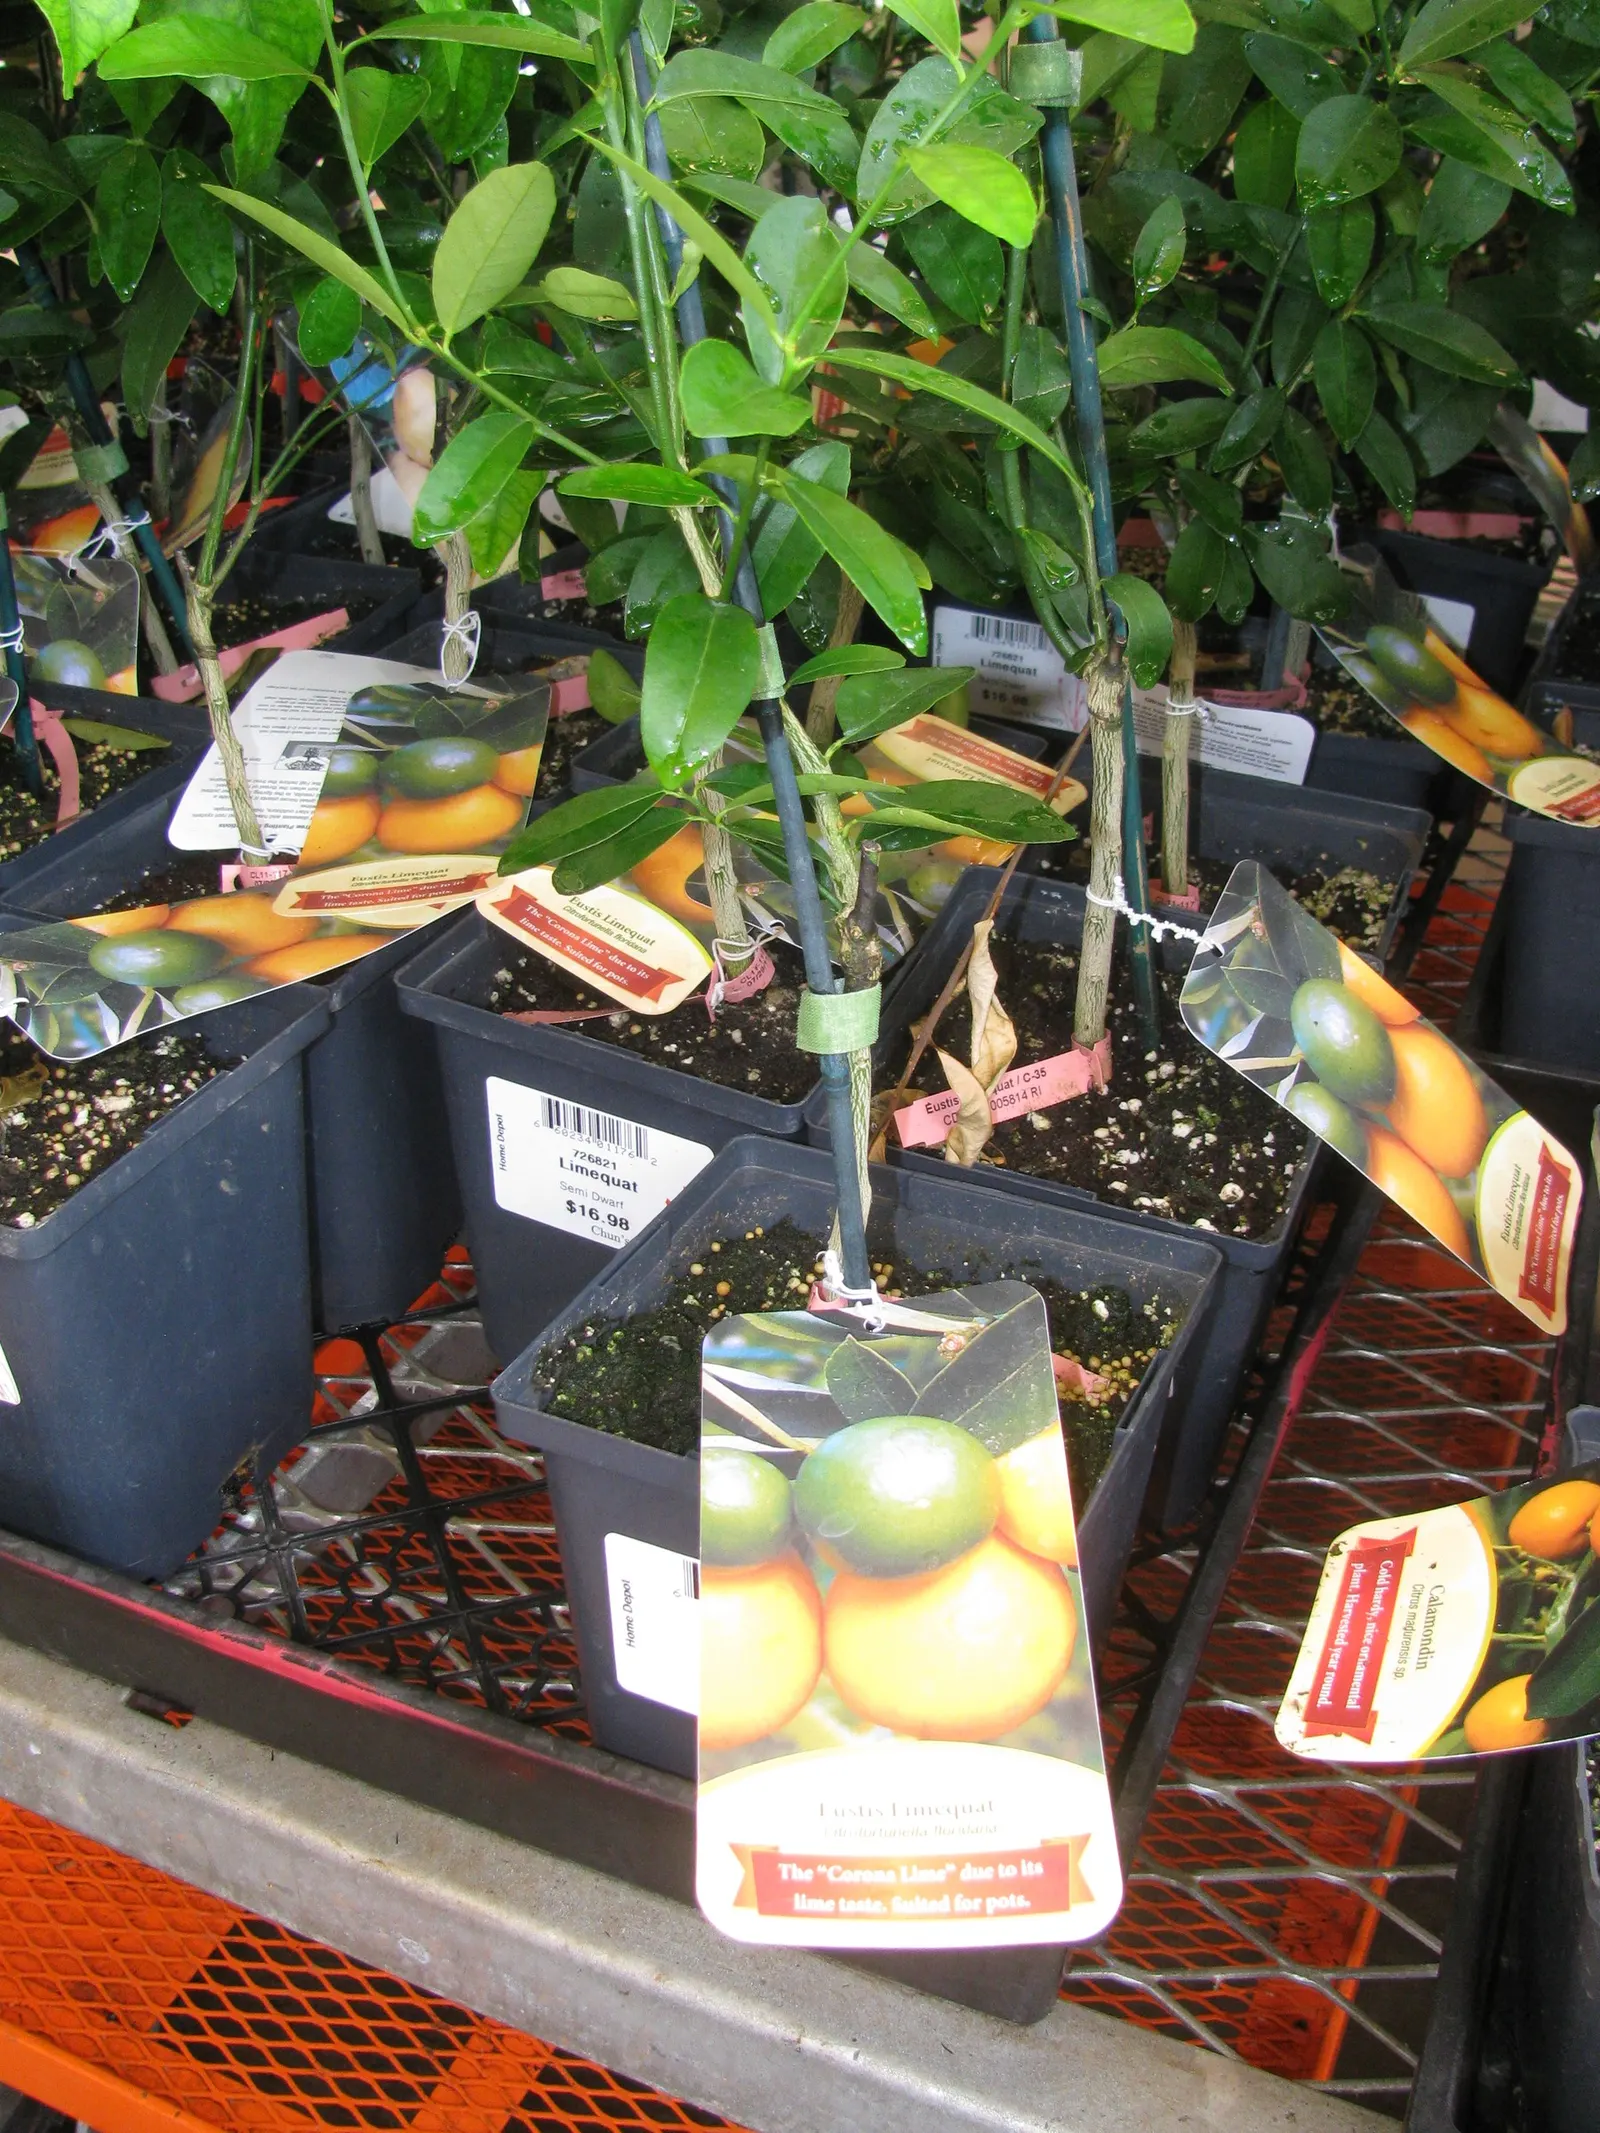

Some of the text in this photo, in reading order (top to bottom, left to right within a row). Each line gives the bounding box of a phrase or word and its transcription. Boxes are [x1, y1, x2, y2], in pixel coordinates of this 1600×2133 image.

[980, 658, 1038, 677] Limequat
[351, 868, 450, 882] Eustis Limequat
[387, 886, 418, 895] Lime”
[419, 883, 438, 891] due
[349, 898, 375, 906] taste.
[378, 894, 409, 903] Suited
[427, 889, 453, 898] pots.
[562, 905, 648, 954] Citrofortunella floridana
[569, 896, 656, 946] Eustis Limequat
[519, 917, 629, 986] lime taste. Suited for pots.
[525, 904, 649, 980] The “Corona Lime” due to its
[925, 1097, 960, 1114] Eustis
[1022, 1067, 1047, 1083] C-35
[1031, 1086, 1042, 1098] RI
[495, 1113, 507, 1171] Home Depot
[533, 1119, 541, 1128] 6
[651, 1157, 658, 1166] 2
[572, 1149, 617, 1171] 726821
[559, 1157, 639, 1193] Limequat
[560, 1181, 624, 1210] Semi Dwarf
[1544, 1173, 1553, 1184] its
[566, 1199, 630, 1231] $16.98
[1501, 1163, 1522, 1244] Eustis Limequat
[1540, 1194, 1549, 1211] due
[1543, 1273, 1551, 1294] lime
[1548, 1226, 1558, 1250] Suited
[1556, 1194, 1565, 1215] pots.
[1529, 1270, 1538, 1286] The
[621, 1579, 636, 1648] Home Depot
[1394, 1583, 1425, 1681] Citrus madurensis sp.
[1416, 1584, 1446, 1671] Calamondin
[1316, 1562, 1366, 1708] plant. Harvested year round.
[1346, 1560, 1394, 1709] Cold hardy, nice ornamental
[778, 1859, 1044, 1884] The “Corona Lime” due to its
[793, 1892, 1031, 1915] lime taste. Suited for pots.
